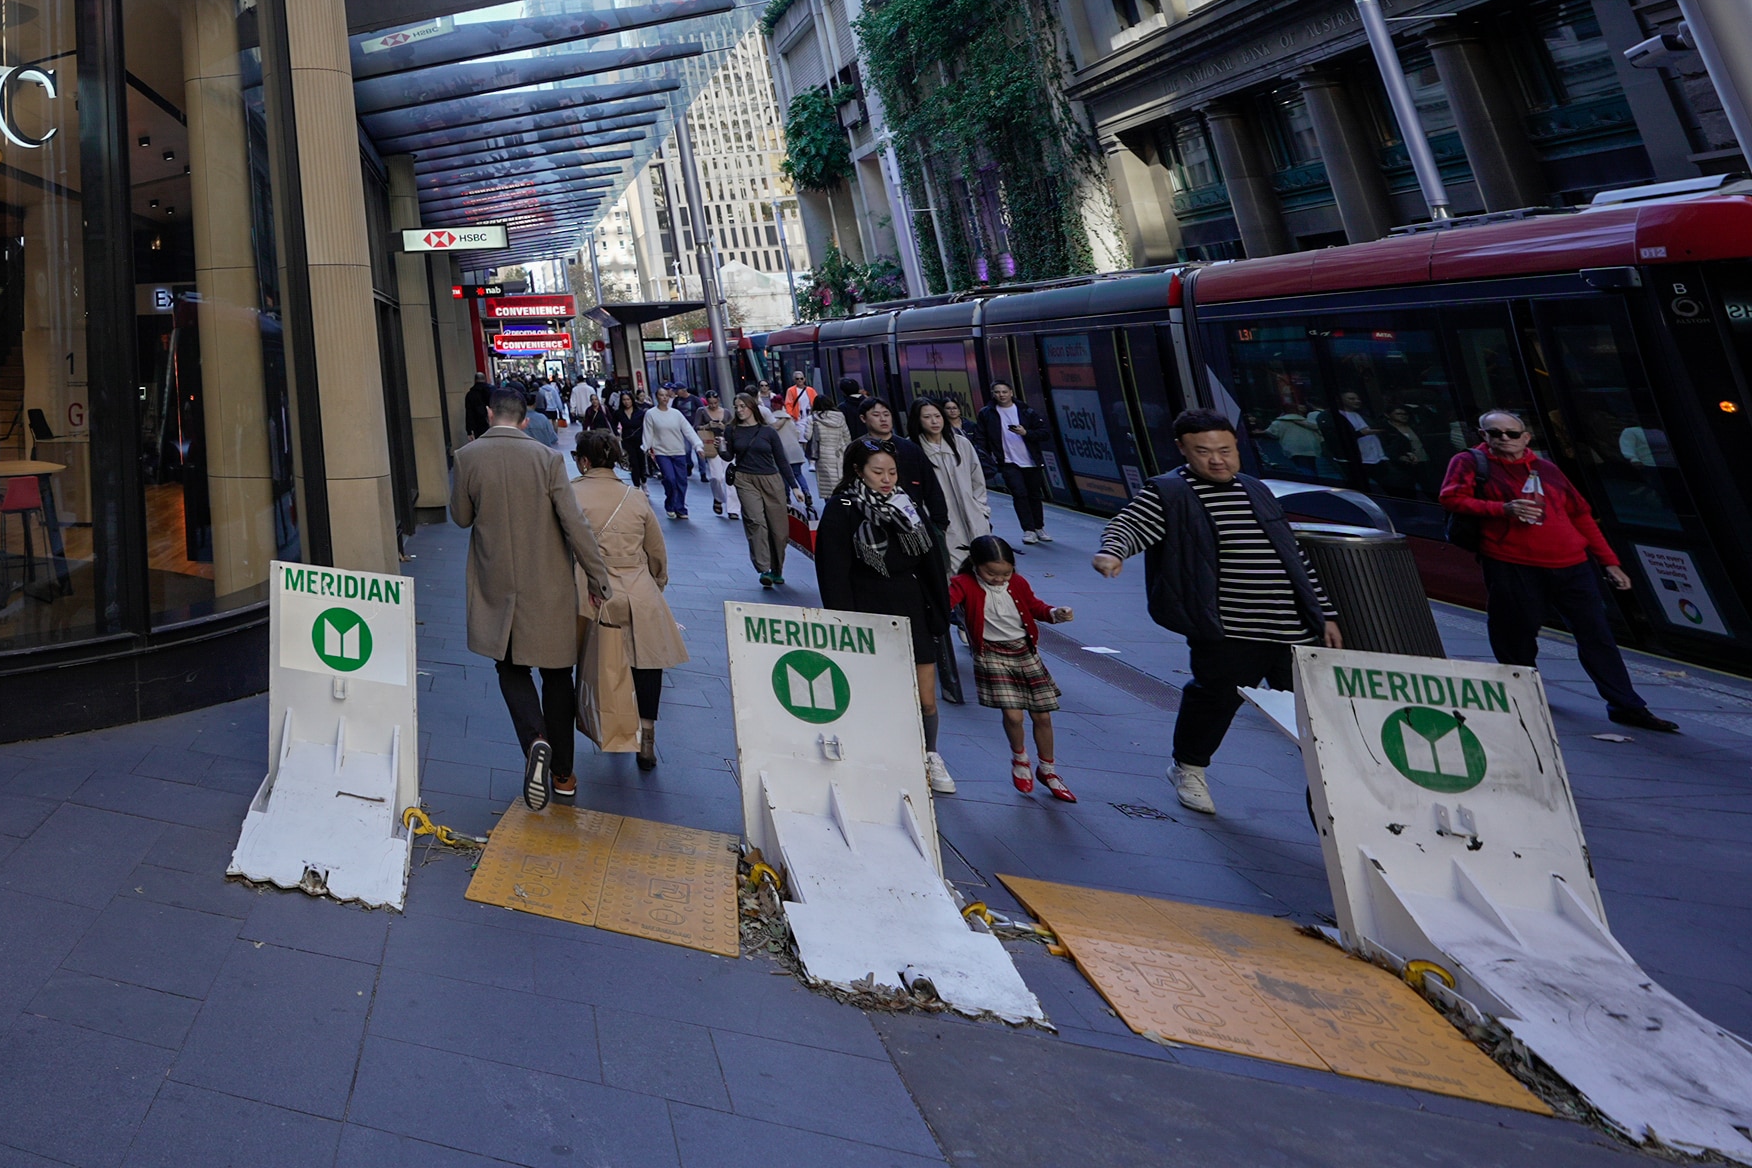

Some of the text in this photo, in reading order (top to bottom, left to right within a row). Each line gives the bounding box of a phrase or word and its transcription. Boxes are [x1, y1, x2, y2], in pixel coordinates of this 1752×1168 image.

[1185, 56, 1235, 85] NATIONAL
[1241, 43, 1271, 65] BANK
[1279, 32, 1296, 49] OF
[458, 233, 487, 243] HSBC
[1640, 247, 1666, 259] 012
[485, 286, 502, 295] nab
[1672, 282, 1688, 295] B
[495, 305, 567, 317] CONVENIENCE
[502, 340, 564, 349] CONVENIENCE
[595, 342, 603, 351] L
[65, 352, 75, 375] 1
[67, 402, 84, 427] G
[1062, 405, 1097, 437] Tasty
[1064, 434, 1114, 463] treats%
[1642, 550, 1656, 560] Tap
[1666, 555, 1685, 565] every
[1648, 559, 1688, 572] time before
[1655, 567, 1689, 582] boarding
[284, 567, 402, 606] MERIDIAN
[743, 615, 876, 656] MERIDIAN
[1332, 666, 1511, 713] MERIDIAN
